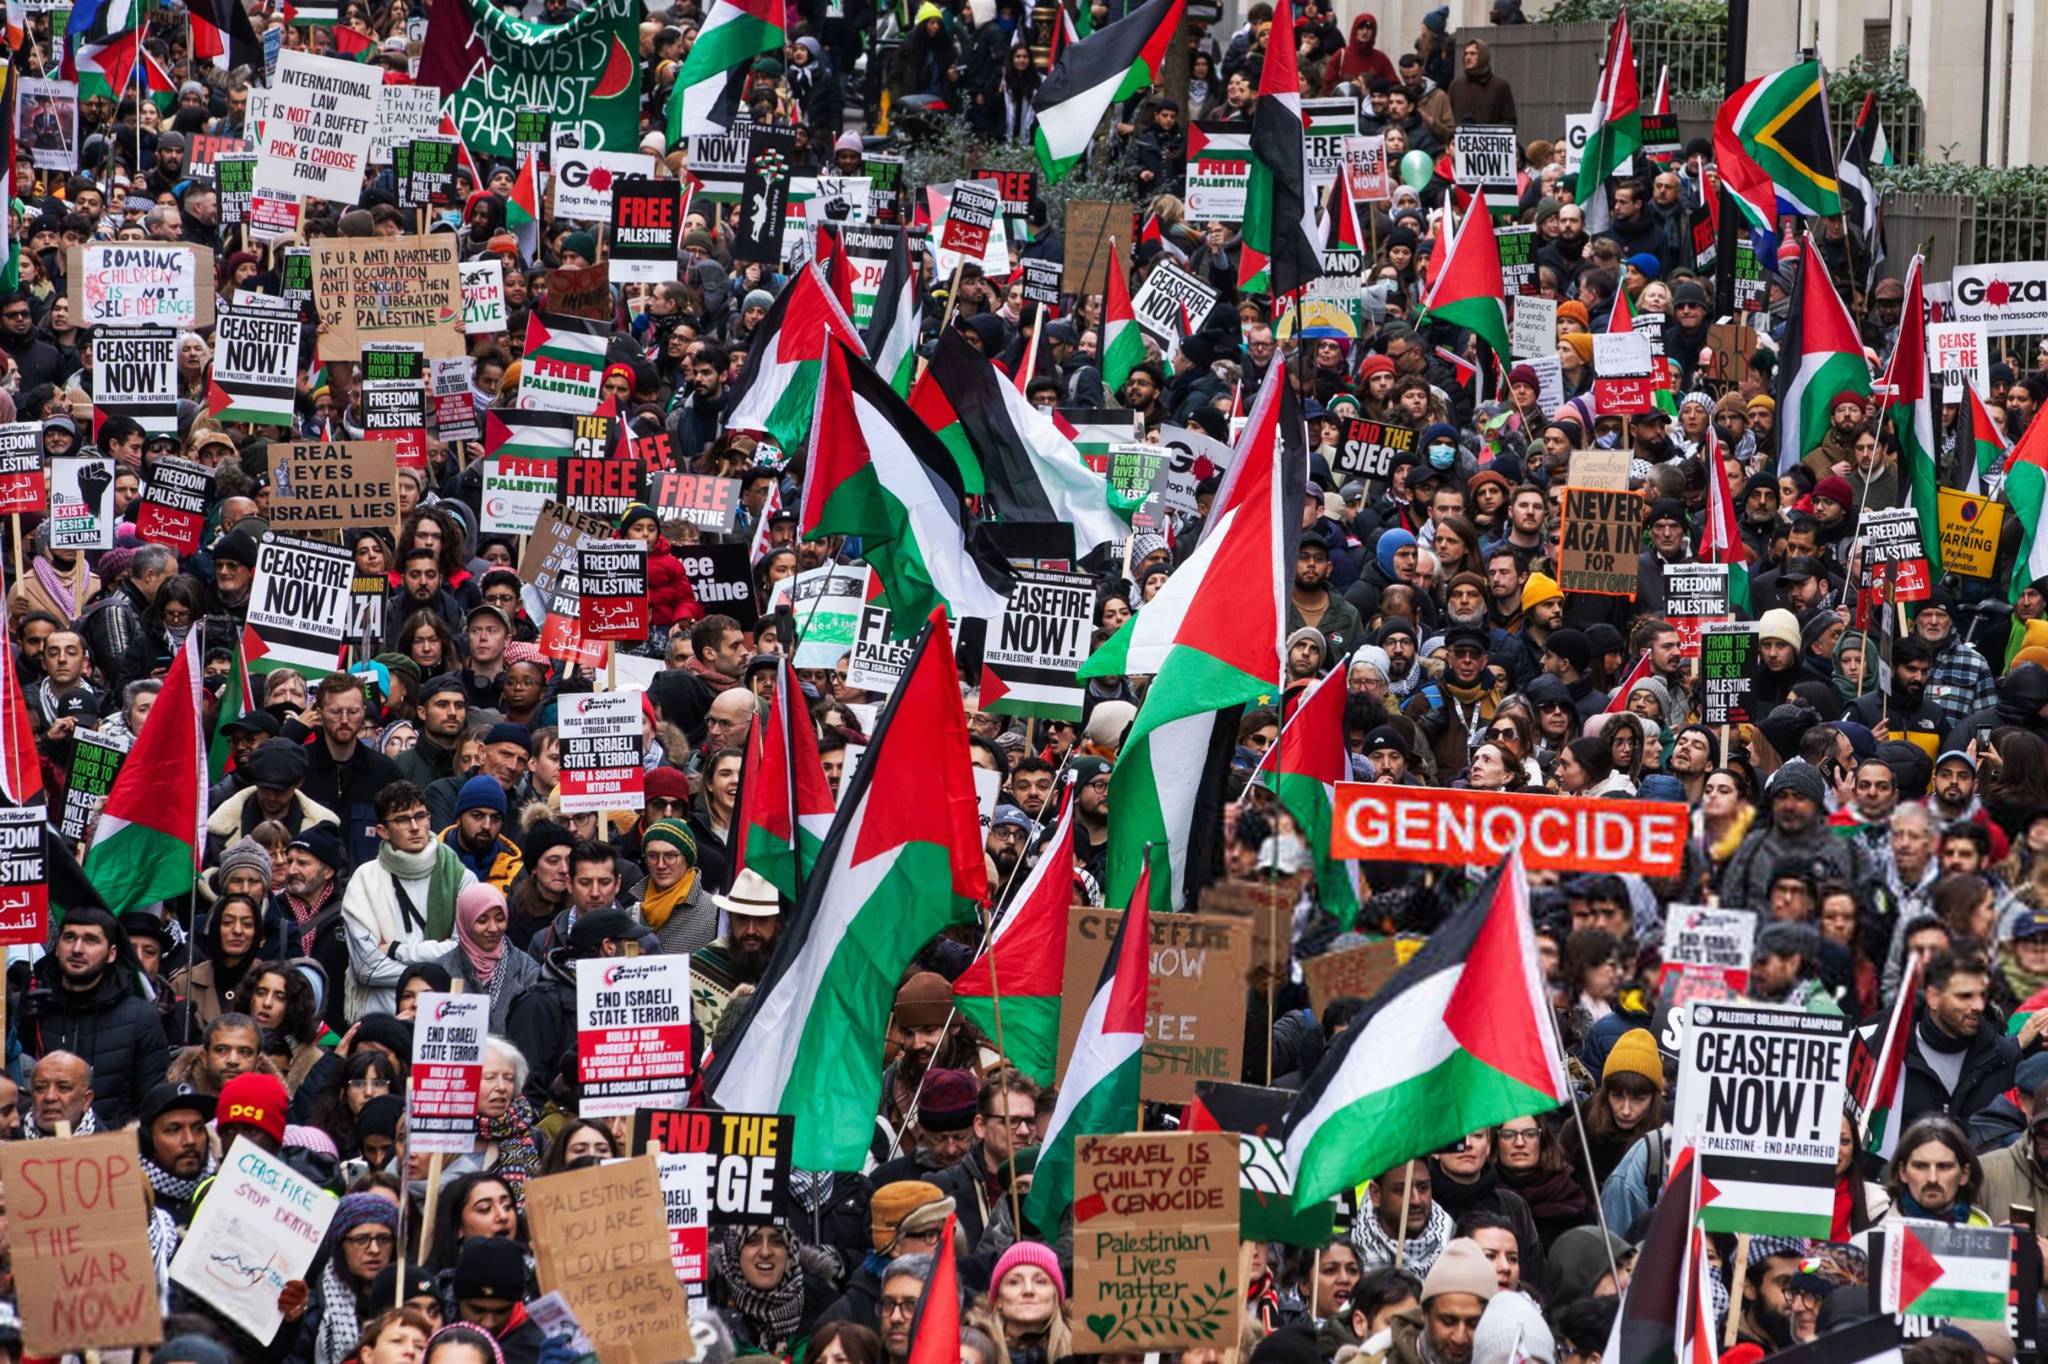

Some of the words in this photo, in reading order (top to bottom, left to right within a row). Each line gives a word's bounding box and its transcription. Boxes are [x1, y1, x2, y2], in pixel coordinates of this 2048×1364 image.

[465, 19, 608, 72] ACTIVISTS
[282, 69, 372, 99] INTERNATIONAL
[462, 57, 595, 115] AGAINST
[311, 93, 338, 111] LAW
[272, 104, 284, 118] IS
[287, 107, 310, 124] NOT
[325, 115, 368, 134] BUFFET
[293, 126, 315, 142] YOU
[318, 131, 342, 148] CAN
[1458, 136, 1513, 153] CEASEFIRE
[270, 140, 297, 158] PICK
[311, 148, 357, 169] CHOOSE
[1347, 150, 1383, 164] CEASE
[294, 163, 327, 182] FROM
[1198, 159, 1246, 175] FREE
[1353, 163, 1378, 176] FIRE
[1353, 176, 1380, 190] NOW
[275, 193, 296, 201] TERROR
[956, 191, 996, 210] FREEDOM
[618, 197, 672, 227] FREE
[950, 207, 993, 229] PALESTINE
[617, 228, 672, 243] PALESTINE
[103, 249, 182, 273] BOMBING
[364, 249, 388, 263] ANTI
[394, 249, 451, 264] APARTHEID
[100, 269, 173, 285] CHILDREN
[320, 267, 348, 280] ANTI
[353, 266, 427, 279] OCCUPATION
[108, 286, 122, 299] IS
[322, 281, 349, 294] ANTI
[421, 279, 449, 291] THEN
[461, 286, 497, 300] THEM
[95, 301, 131, 318] SELF
[382, 295, 449, 307] LIBERATION
[1516, 299, 1552, 311] Violence
[357, 310, 435, 326] PALESTINE
[463, 303, 501, 323] LIVE
[1518, 312, 1546, 322] breeds
[2001, 311, 2048, 319] massacre
[220, 317, 297, 345] CEASEFIRE
[1516, 322, 1547, 332] violence
[1515, 333, 1536, 343] Build
[1939, 333, 1977, 348] CEASE
[97, 341, 173, 362] CEASEFIRE
[368, 354, 394, 365] FROM
[399, 353, 414, 365] THE
[368, 365, 394, 377] RIVER
[534, 356, 593, 382] FREE
[267, 376, 294, 384] APARTHEID
[451, 383, 468, 393] TERROR
[522, 375, 597, 399] PALESTINE
[1606, 381, 1639, 394] الحرية
[369, 392, 419, 406] FREEDOM
[1602, 396, 1644, 409] لفلسطين
[367, 413, 422, 427] PALESTINE
[576, 416, 608, 440] THE
[1349, 424, 1380, 443] END
[1384, 426, 1413, 450] THE
[294, 445, 353, 461] REAL
[1113, 454, 1141, 467] FROM
[1144, 454, 1161, 468] THE
[153, 467, 206, 490] FREEDOM
[295, 465, 353, 480] EYES
[567, 460, 637, 497] FREE
[1113, 466, 1140, 478] RIVER
[146, 487, 204, 513] PALESTINE
[296, 483, 391, 500] REALISE
[658, 473, 731, 511] FREE
[54, 504, 88, 517] EXIST.
[270, 505, 343, 521] ISRAEL
[351, 502, 396, 518] LIES
[1567, 491, 1643, 522] NEVER
[55, 518, 94, 531] RESIST.
[152, 510, 189, 527] الحرية
[56, 532, 101, 545] RETURN.
[144, 526, 191, 542] لفلسطين
[261, 547, 349, 589] CEASEFIRE
[584, 554, 640, 570] FREEDOM
[1585, 553, 1615, 572] FOR
[582, 578, 643, 595] PALESTINE
[1561, 571, 1638, 593] EVERYONE
[1669, 576, 1722, 592] FREEDOM
[592, 601, 633, 619] الحرية
[1667, 599, 1724, 615] PALESTINE
[310, 622, 341, 637] APARTHEID
[588, 617, 640, 633] لفلسطين
[1707, 635, 1733, 649] FROM
[1736, 635, 1750, 648] THE
[1706, 649, 1733, 663] RIVER
[1706, 663, 1723, 678] THE
[1726, 664, 1741, 677] SEA
[1706, 678, 1751, 692] PALESTINE
[1706, 694, 1727, 708] WILL
[1706, 709, 1727, 723] FREE
[582, 725, 611, 735] STRUGGLE
[570, 739, 591, 753] END
[593, 737, 633, 752] ISRAELI
[564, 754, 596, 768] STATE
[599, 751, 639, 766] TERROR
[594, 769, 633, 780] SOCIALIST
[1346, 797, 1677, 865] GENOCIDE
[596, 992, 622, 1008] END
[625, 988, 672, 1007] ISRAELI
[589, 1009, 628, 1027] STATE
[632, 1006, 679, 1024] TERROR
[1716, 1010, 1756, 1025] PALESTINE
[1756, 1014, 1800, 1029] SOLIDARITY
[1800, 1018, 1843, 1031] CAMPAIGN
[426, 1028, 444, 1044] END
[446, 1026, 477, 1044] ISRAELI
[606, 1031, 630, 1043] BUILD
[640, 1029, 659, 1042] NEW
[420, 1045, 448, 1061] STATE
[450, 1045, 479, 1062] TERROR
[639, 1040, 663, 1052] PARTY
[1696, 1032, 1842, 1082] CEASEFIRE
[645, 1063, 684, 1076] STARMER
[651, 1112, 710, 1153] END
[722, 1115, 778, 1157] THE
[1093, 1145, 1168, 1167] ISRAEL
[1187, 1142, 1210, 1164] IS
[1708, 1137, 1756, 1153] PALESTINE
[1764, 1141, 1782, 1154] END
[1785, 1142, 1835, 1158] APARTHEID
[17, 1154, 131, 1220] STOP
[1093, 1167, 1170, 1193] GUILTY
[1179, 1165, 1208, 1186] OF
[1112, 1188, 1225, 1217] GENOCIDE
[273, 1207, 321, 1245] DEATHS
[560, 1222, 597, 1244] YOU
[604, 1208, 644, 1233] ARE
[28, 1226, 82, 1260] THE
[1096, 1230, 1210, 1259] Palestinian
[1939, 1236, 1992, 1249] JUSTICE
[60, 1251, 131, 1289] WAR
[1116, 1257, 1176, 1277] Lives
[606, 1272, 659, 1303] CARE
[1099, 1280, 1190, 1300] matter
[52, 1284, 146, 1334] NOW
